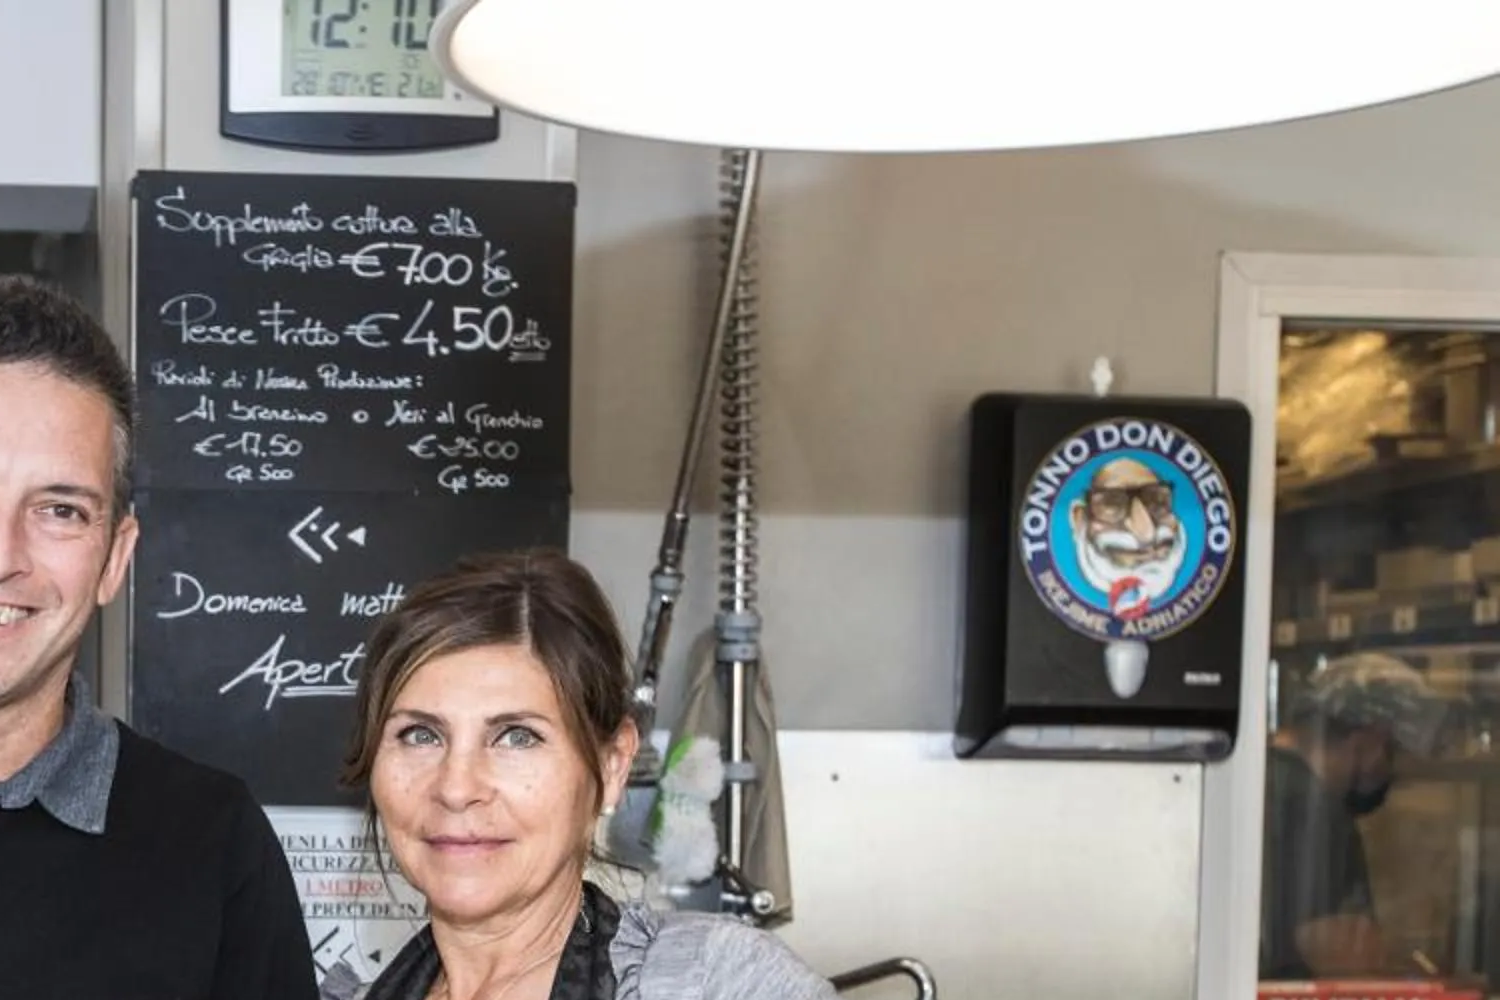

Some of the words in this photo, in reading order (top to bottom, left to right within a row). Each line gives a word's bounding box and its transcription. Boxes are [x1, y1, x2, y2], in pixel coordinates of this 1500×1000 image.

[428, 207, 482, 238] alla
[159, 293, 259, 344] Pesce
[257, 301, 340, 346] Fritto
[1022, 437, 1090, 561] TONNO
[1095, 420, 1175, 455] DON
[1175, 441, 1231, 553] DIEGO
[156, 571, 308, 620] Domenica
[1121, 563, 1217, 637] ADRIATICO
